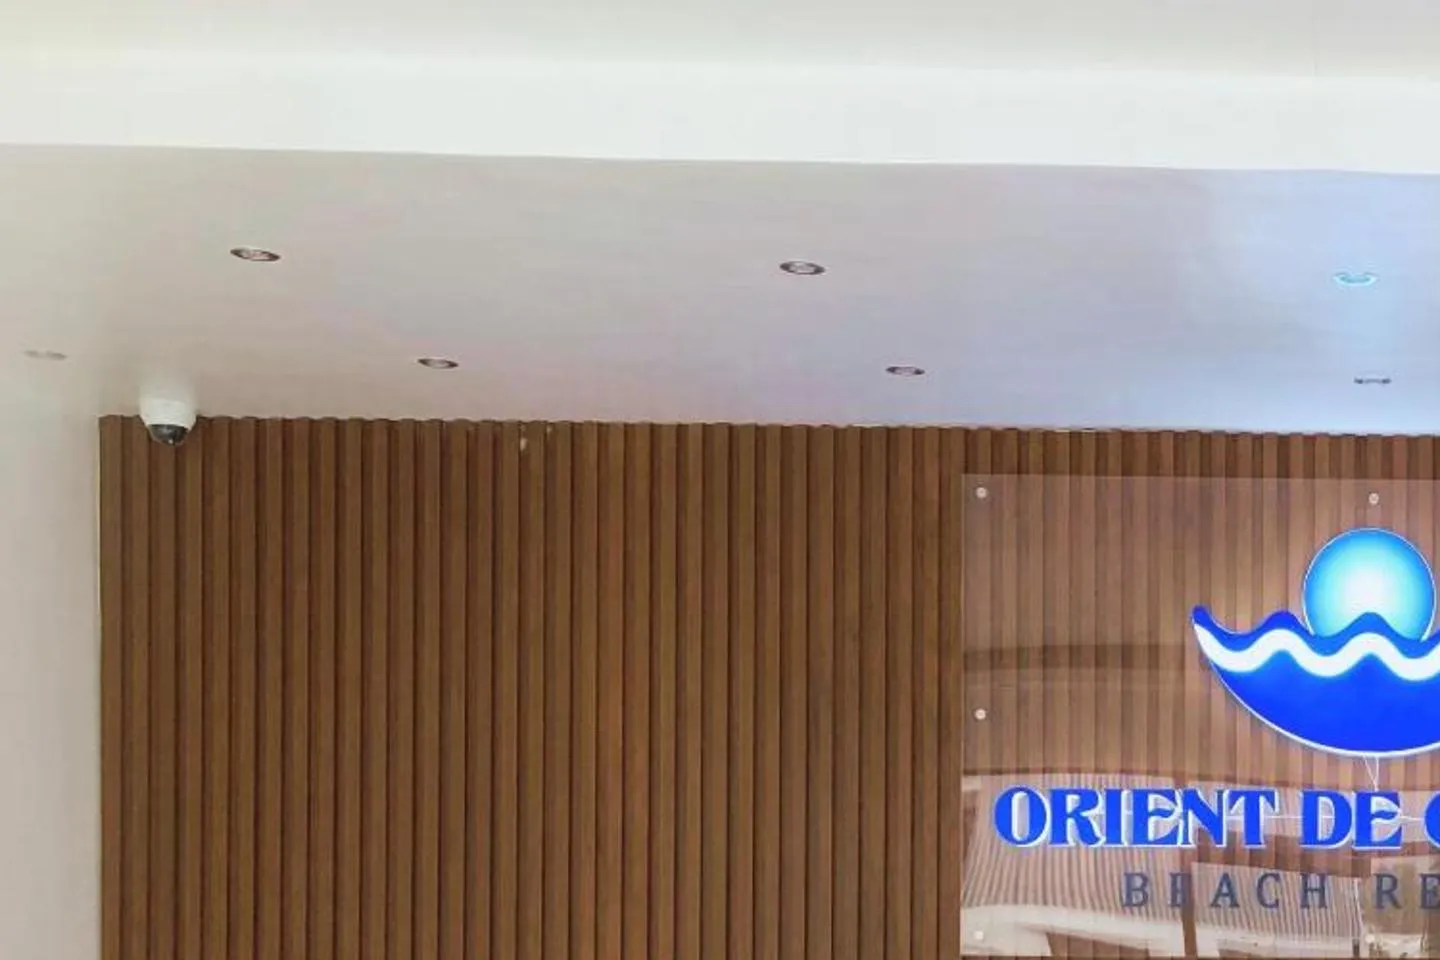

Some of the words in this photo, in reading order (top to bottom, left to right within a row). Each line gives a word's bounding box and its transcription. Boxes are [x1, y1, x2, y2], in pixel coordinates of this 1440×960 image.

[993, 786, 1277, 848] ORIENT
[1300, 789, 1403, 850] DE
[1122, 871, 1330, 909] BEACH
